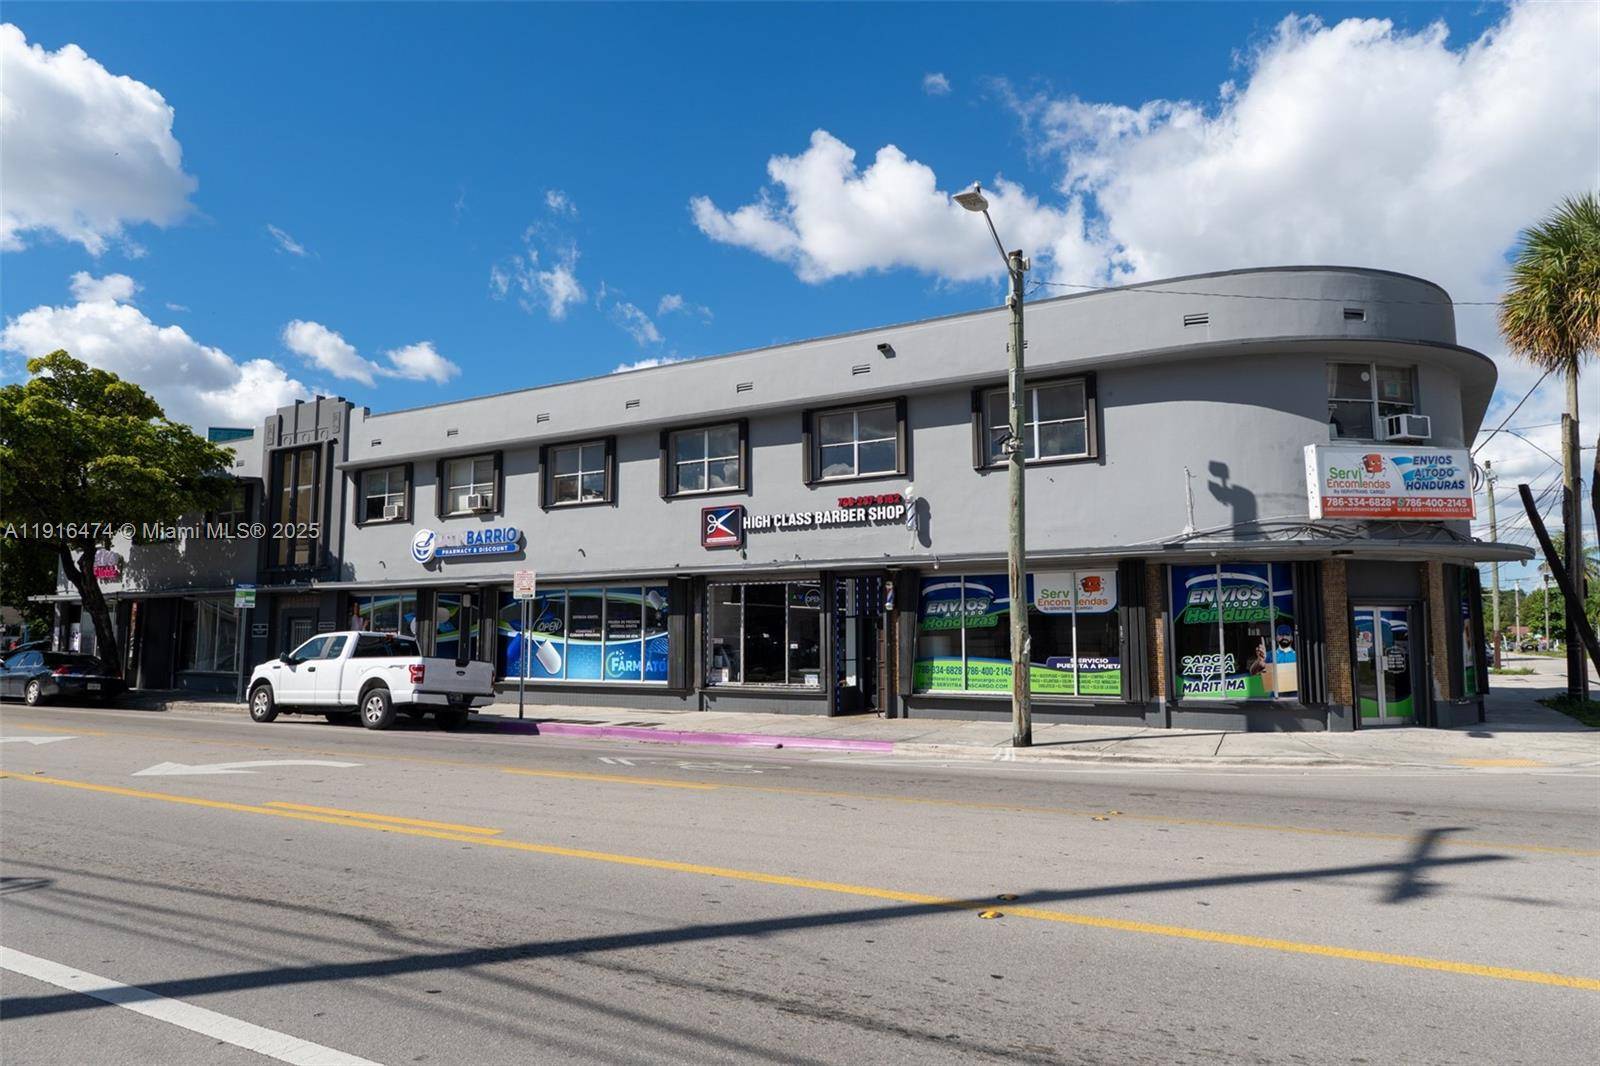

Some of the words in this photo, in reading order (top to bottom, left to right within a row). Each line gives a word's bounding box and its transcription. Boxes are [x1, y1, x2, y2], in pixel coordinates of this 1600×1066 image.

[1412, 456, 1453, 466] ENVIOS
[1406, 480, 1466, 492] HONDURAS
[1327, 498, 1392, 507] 786-334-6828
[1405, 498, 1468, 507] 786-400-2145
[743, 515, 769, 530] HIGH
[774, 512, 811, 528] CLASS
[815, 508, 864, 525] BARBER
[868, 504, 904, 522] SHOP
[467, 528, 517, 545] BARRIO
[479, 545, 508, 553] DISCOUNT
[1189, 588, 1263, 604] ENVIOS
[1183, 654, 1234, 665] CARGA
[1183, 664, 1235, 675] AEREA
